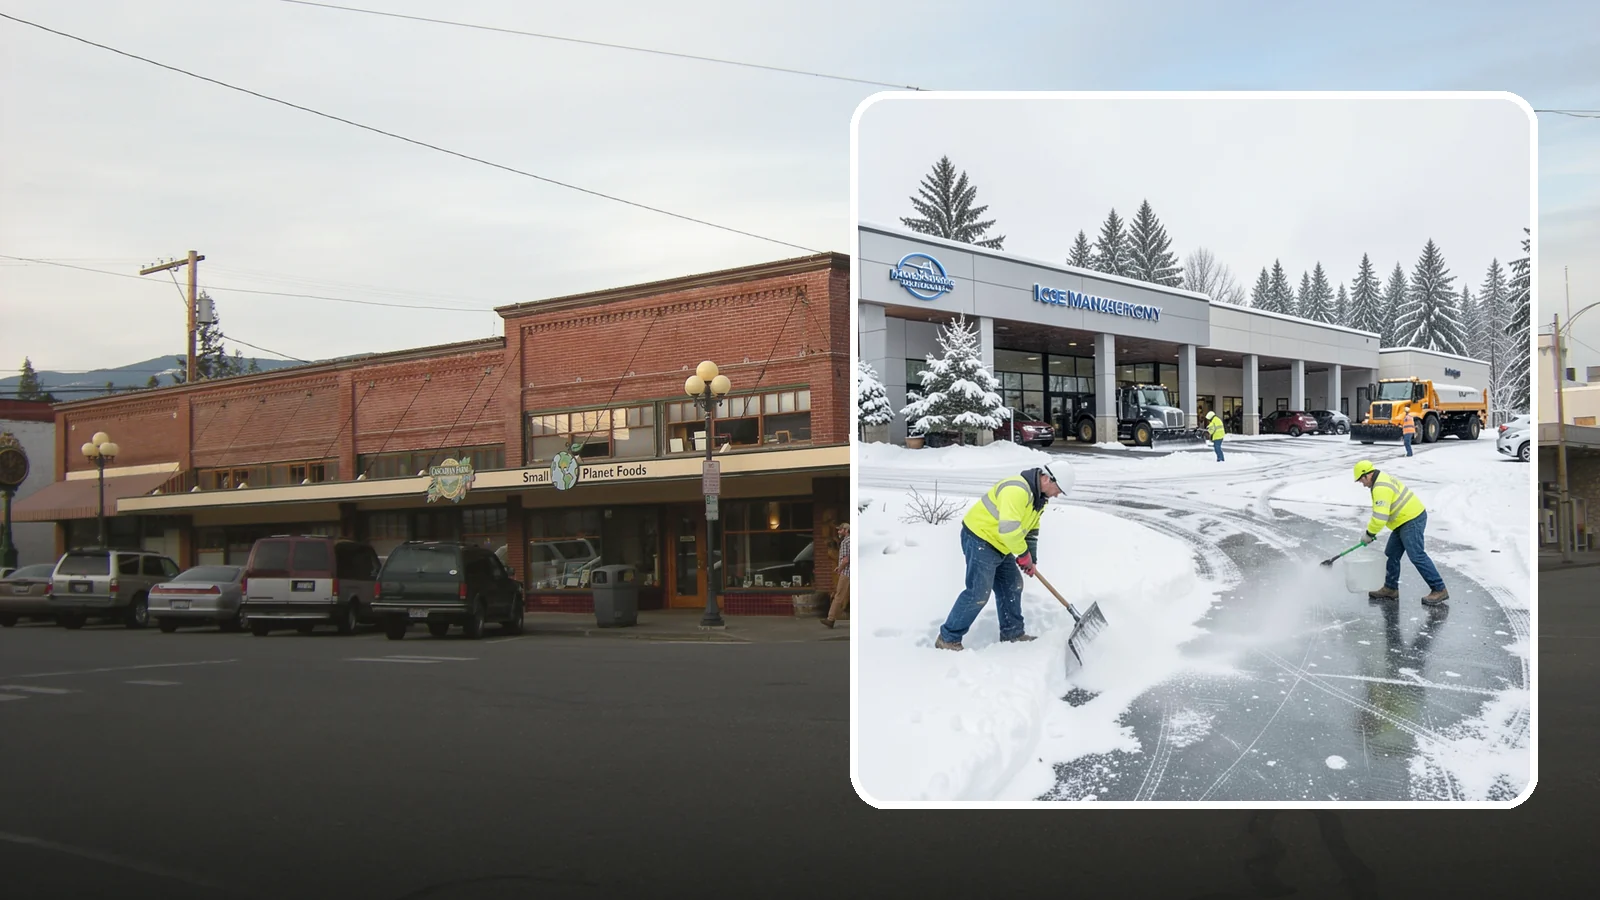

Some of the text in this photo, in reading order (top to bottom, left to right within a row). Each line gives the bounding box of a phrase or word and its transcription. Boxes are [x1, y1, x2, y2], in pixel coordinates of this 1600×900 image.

[523, 464, 647, 483] Small Planet Foods
